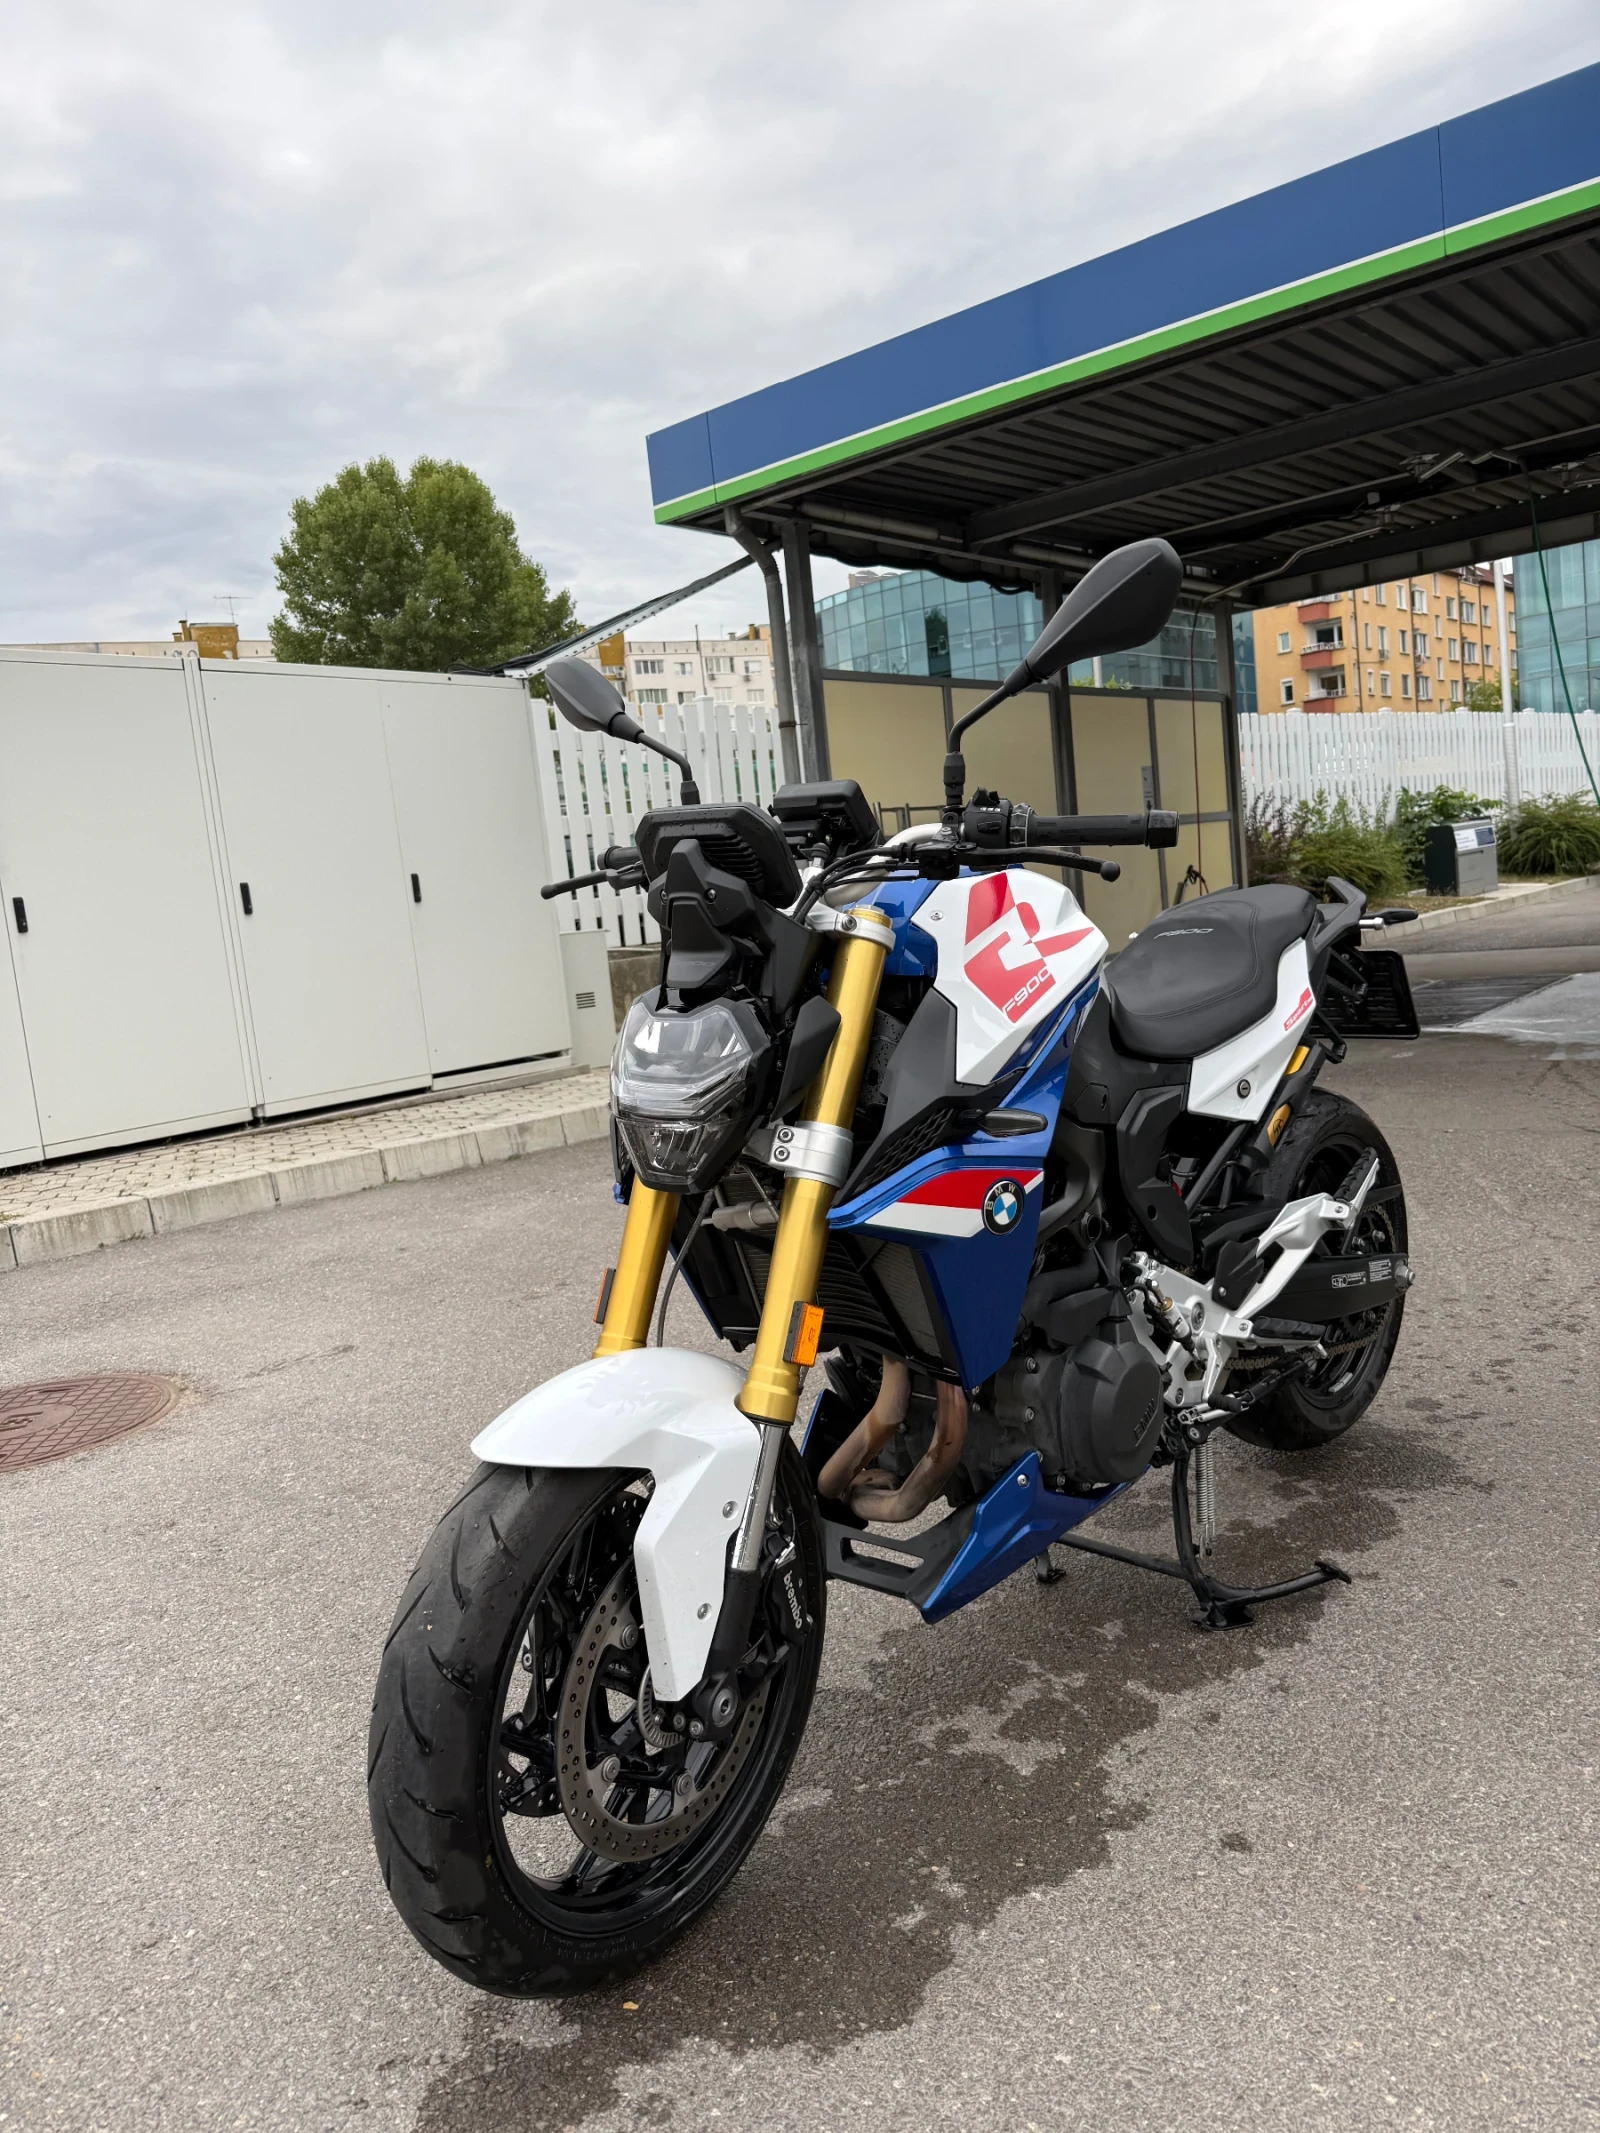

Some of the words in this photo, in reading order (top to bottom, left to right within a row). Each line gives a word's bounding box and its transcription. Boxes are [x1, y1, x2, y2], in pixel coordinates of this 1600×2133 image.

[1153, 928, 1214, 940] F900
[1001, 965, 1053, 1014] F900
[985, 1183, 1016, 1210] BMW
[783, 1569, 803, 1629] brembo
